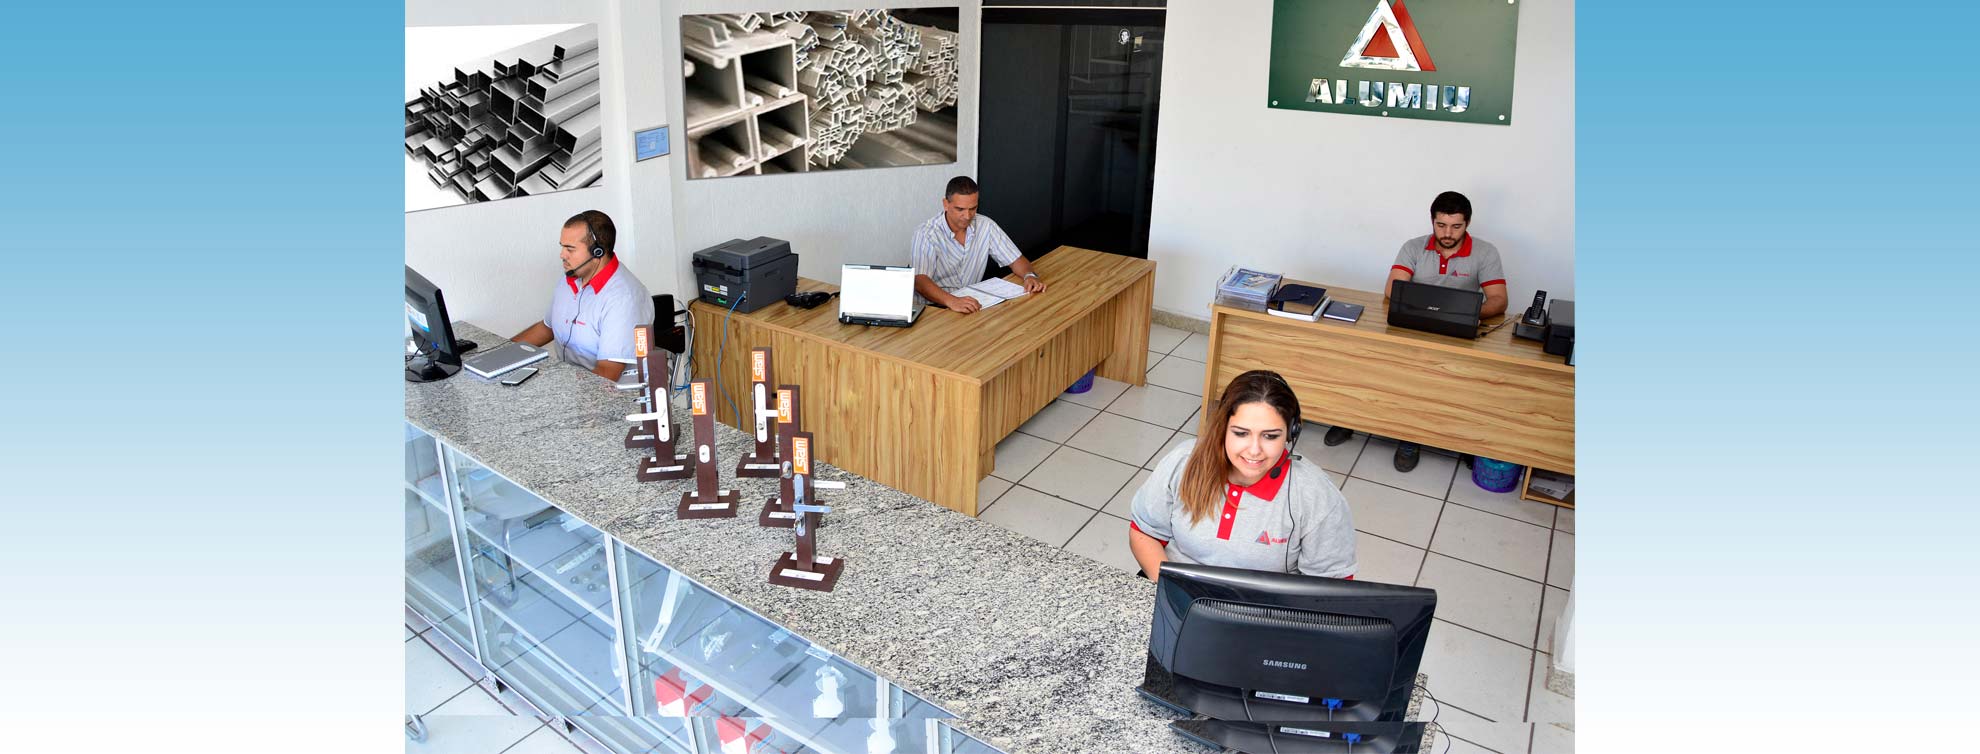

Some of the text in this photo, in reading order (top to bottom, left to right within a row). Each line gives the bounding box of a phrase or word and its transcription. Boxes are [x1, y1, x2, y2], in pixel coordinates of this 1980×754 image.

[1304, 78, 1471, 113] ALUMIU
[636, 329, 647, 356] stam
[753, 352, 764, 380] stam
[692, 383, 705, 413] stam
[779, 392, 791, 421] stam
[794, 440, 807, 472] stam
[1263, 658, 1308, 671] SAMSUNG
